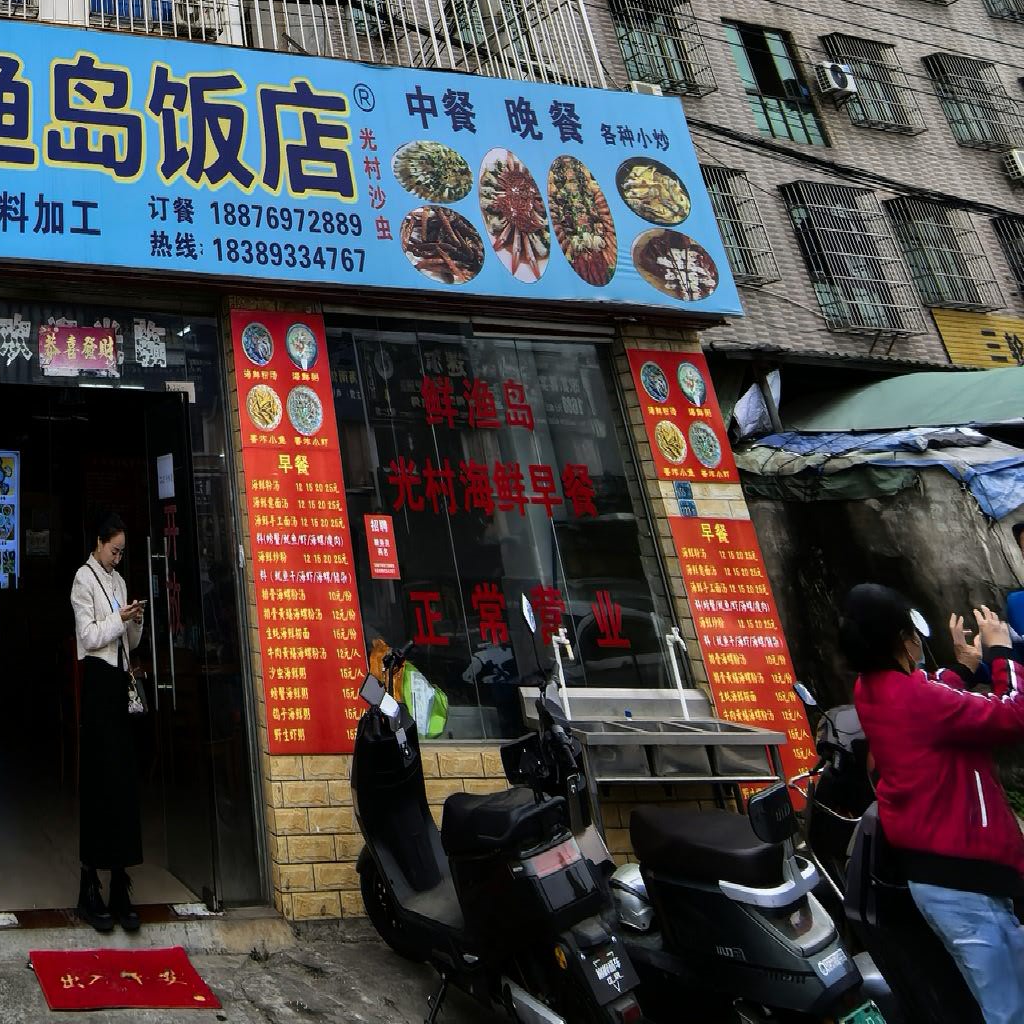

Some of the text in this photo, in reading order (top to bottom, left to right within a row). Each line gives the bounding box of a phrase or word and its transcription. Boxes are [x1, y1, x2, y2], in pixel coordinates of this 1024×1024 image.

[405, 85, 477, 134] 中餐
[504, 96, 584, 145] 晚餐
[600, 123, 670, 152] 各种小炒
[359, 128, 393, 241] 光村沙虫
[148, 194, 363, 237] 订餐 18876972889
[212, 237, 366, 273] 18389334767
[421, 376, 535, 432] 鲜渔岛
[278, 454, 310, 475] 早餐
[389, 455, 599, 518] 光村海鲜早餐
[700, 523, 729, 544] 早餐
[408, 582, 631, 649] 正常营业
